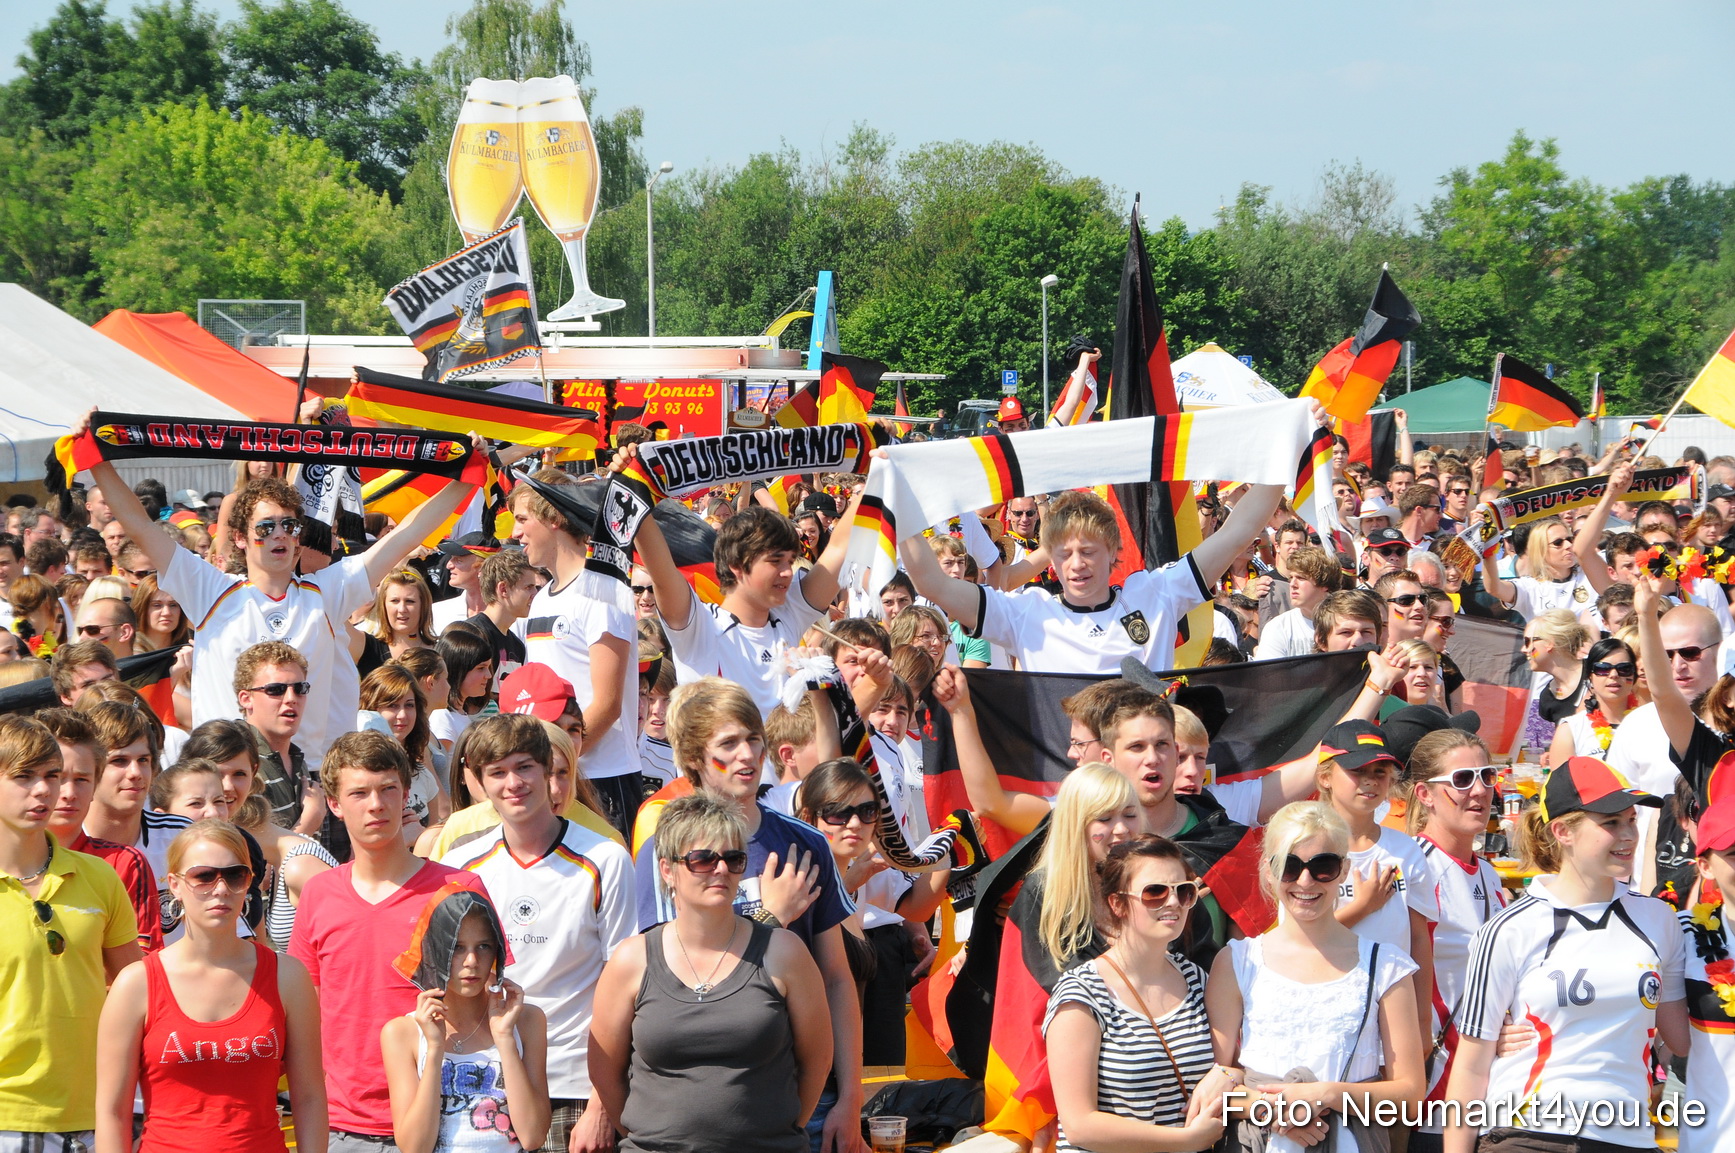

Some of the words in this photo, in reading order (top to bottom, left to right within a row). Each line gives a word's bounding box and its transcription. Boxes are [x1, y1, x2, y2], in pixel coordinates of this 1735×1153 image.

[460, 141, 519, 163] KULMBACHER
[526, 140, 587, 162] KULMBACHER
[561, 382, 607, 398] Min
[643, 382, 715, 399] Donuts
[1005, 372, 1014, 384] P
[664, 401, 682, 415] 93
[687, 401, 704, 415] 96
[147, 423, 420, 461] DEUTSCHLAND
[654, 425, 845, 490] DEUTSCHLAND
[1512, 474, 1677, 518] DEUTSCAND
[1547, 968, 1596, 1007] 16
[159, 1028, 279, 1064] Angel
